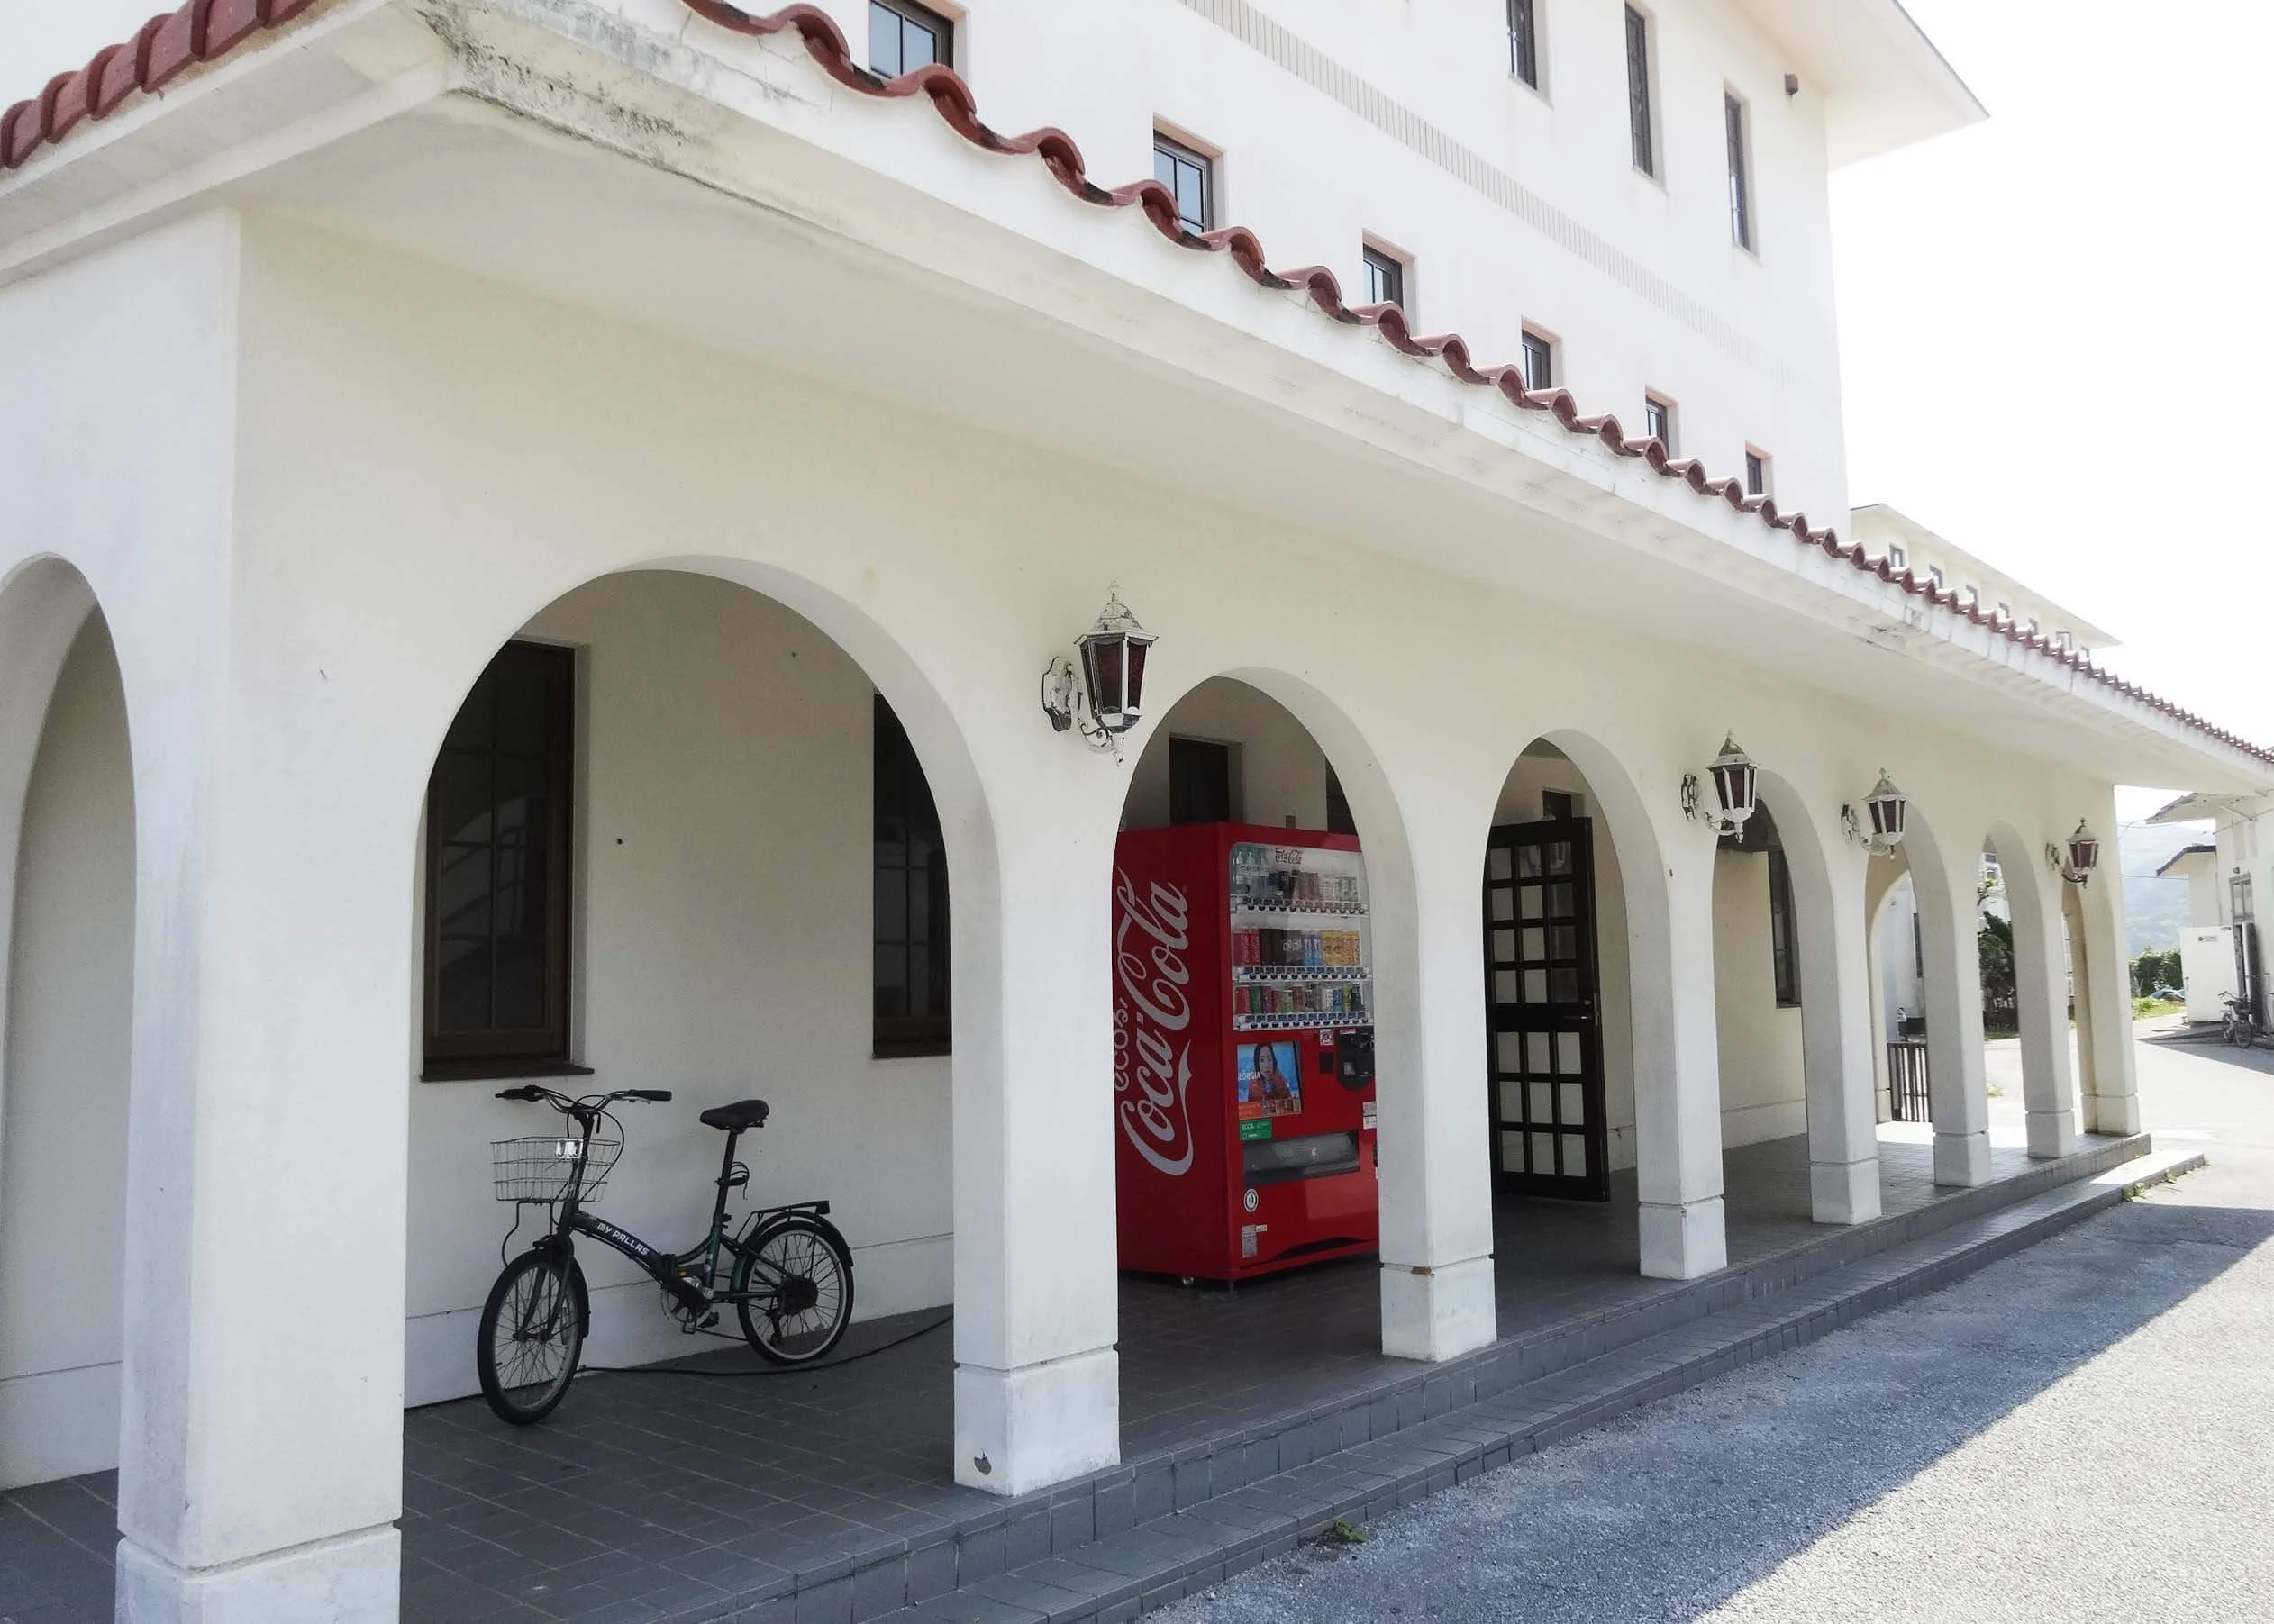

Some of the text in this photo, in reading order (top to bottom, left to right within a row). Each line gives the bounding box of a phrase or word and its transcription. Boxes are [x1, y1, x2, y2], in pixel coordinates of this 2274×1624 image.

[1117, 865, 1194, 1175] Coca-Cola
[597, 1222, 650, 1256] MY PALLAS
